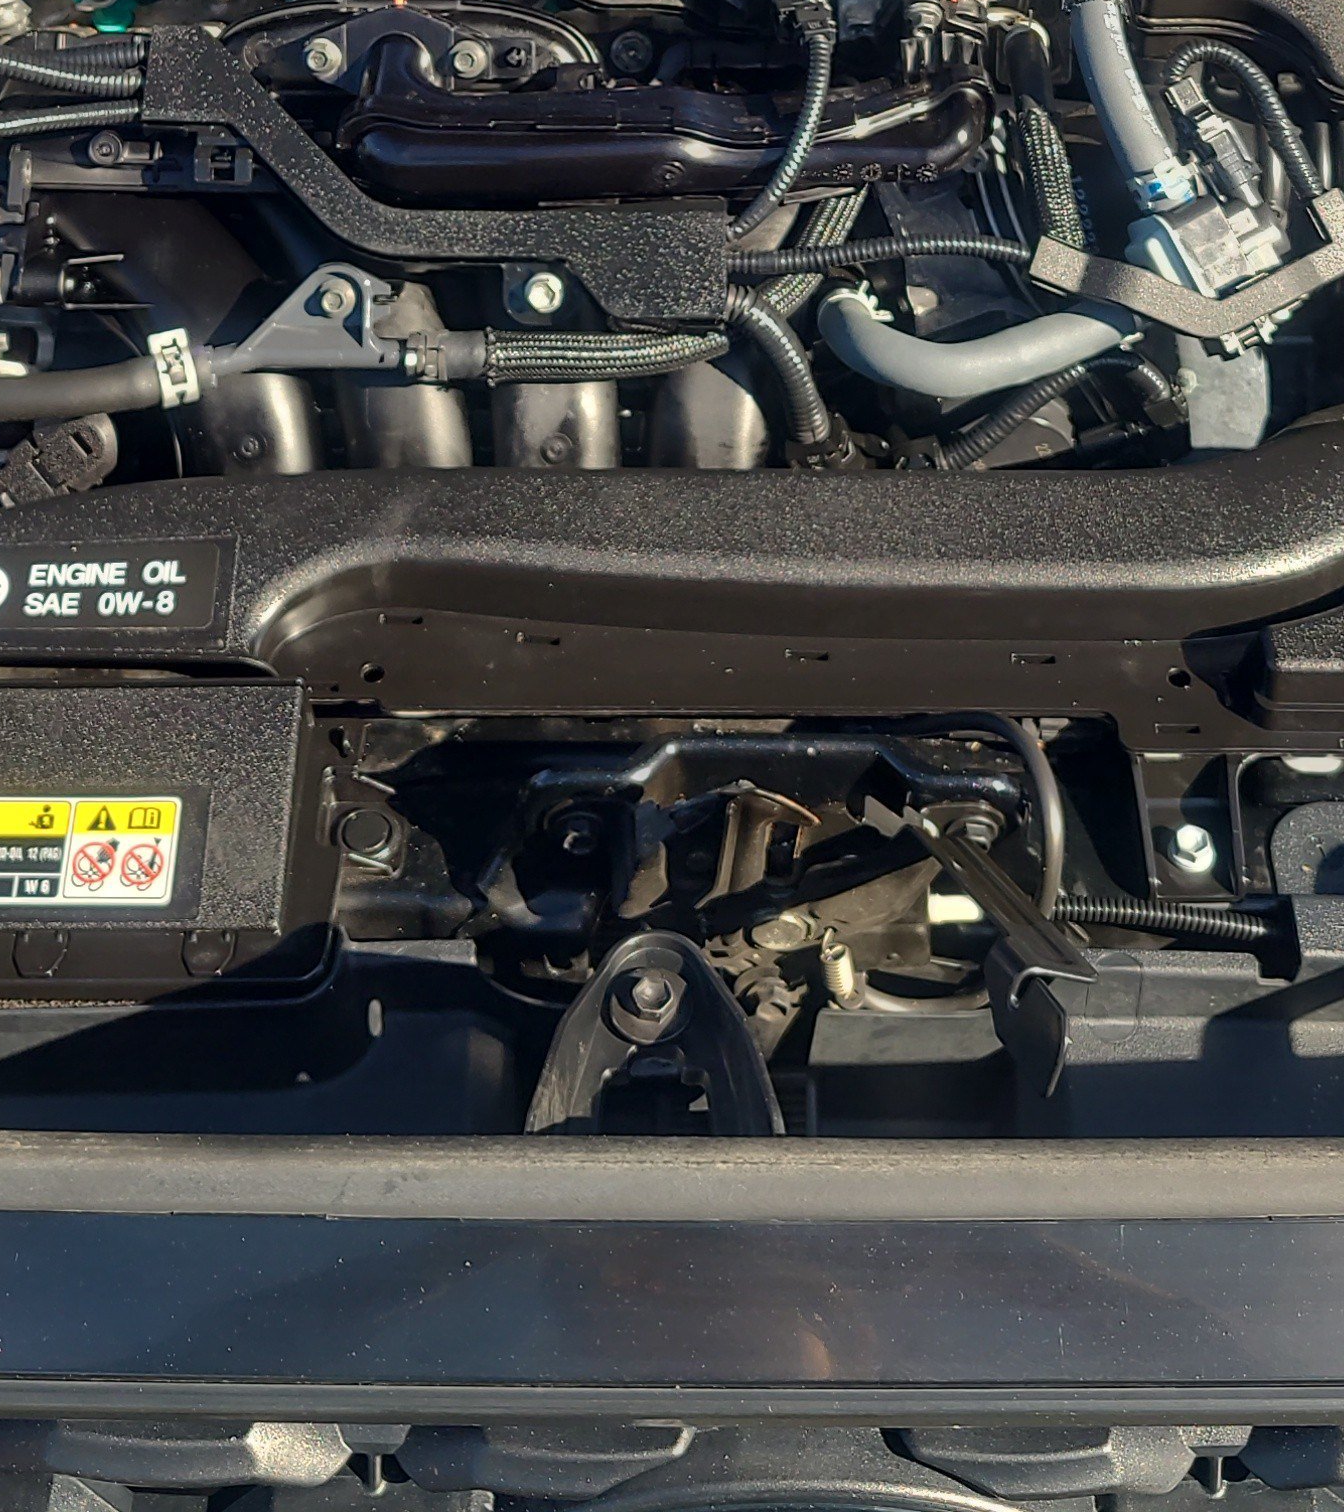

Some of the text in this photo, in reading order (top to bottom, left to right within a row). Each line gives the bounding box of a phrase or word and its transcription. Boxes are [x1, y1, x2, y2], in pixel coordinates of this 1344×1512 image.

[28, 560, 187, 587] ENGINE OIL
[23, 590, 176, 616] SAE 0W-8
